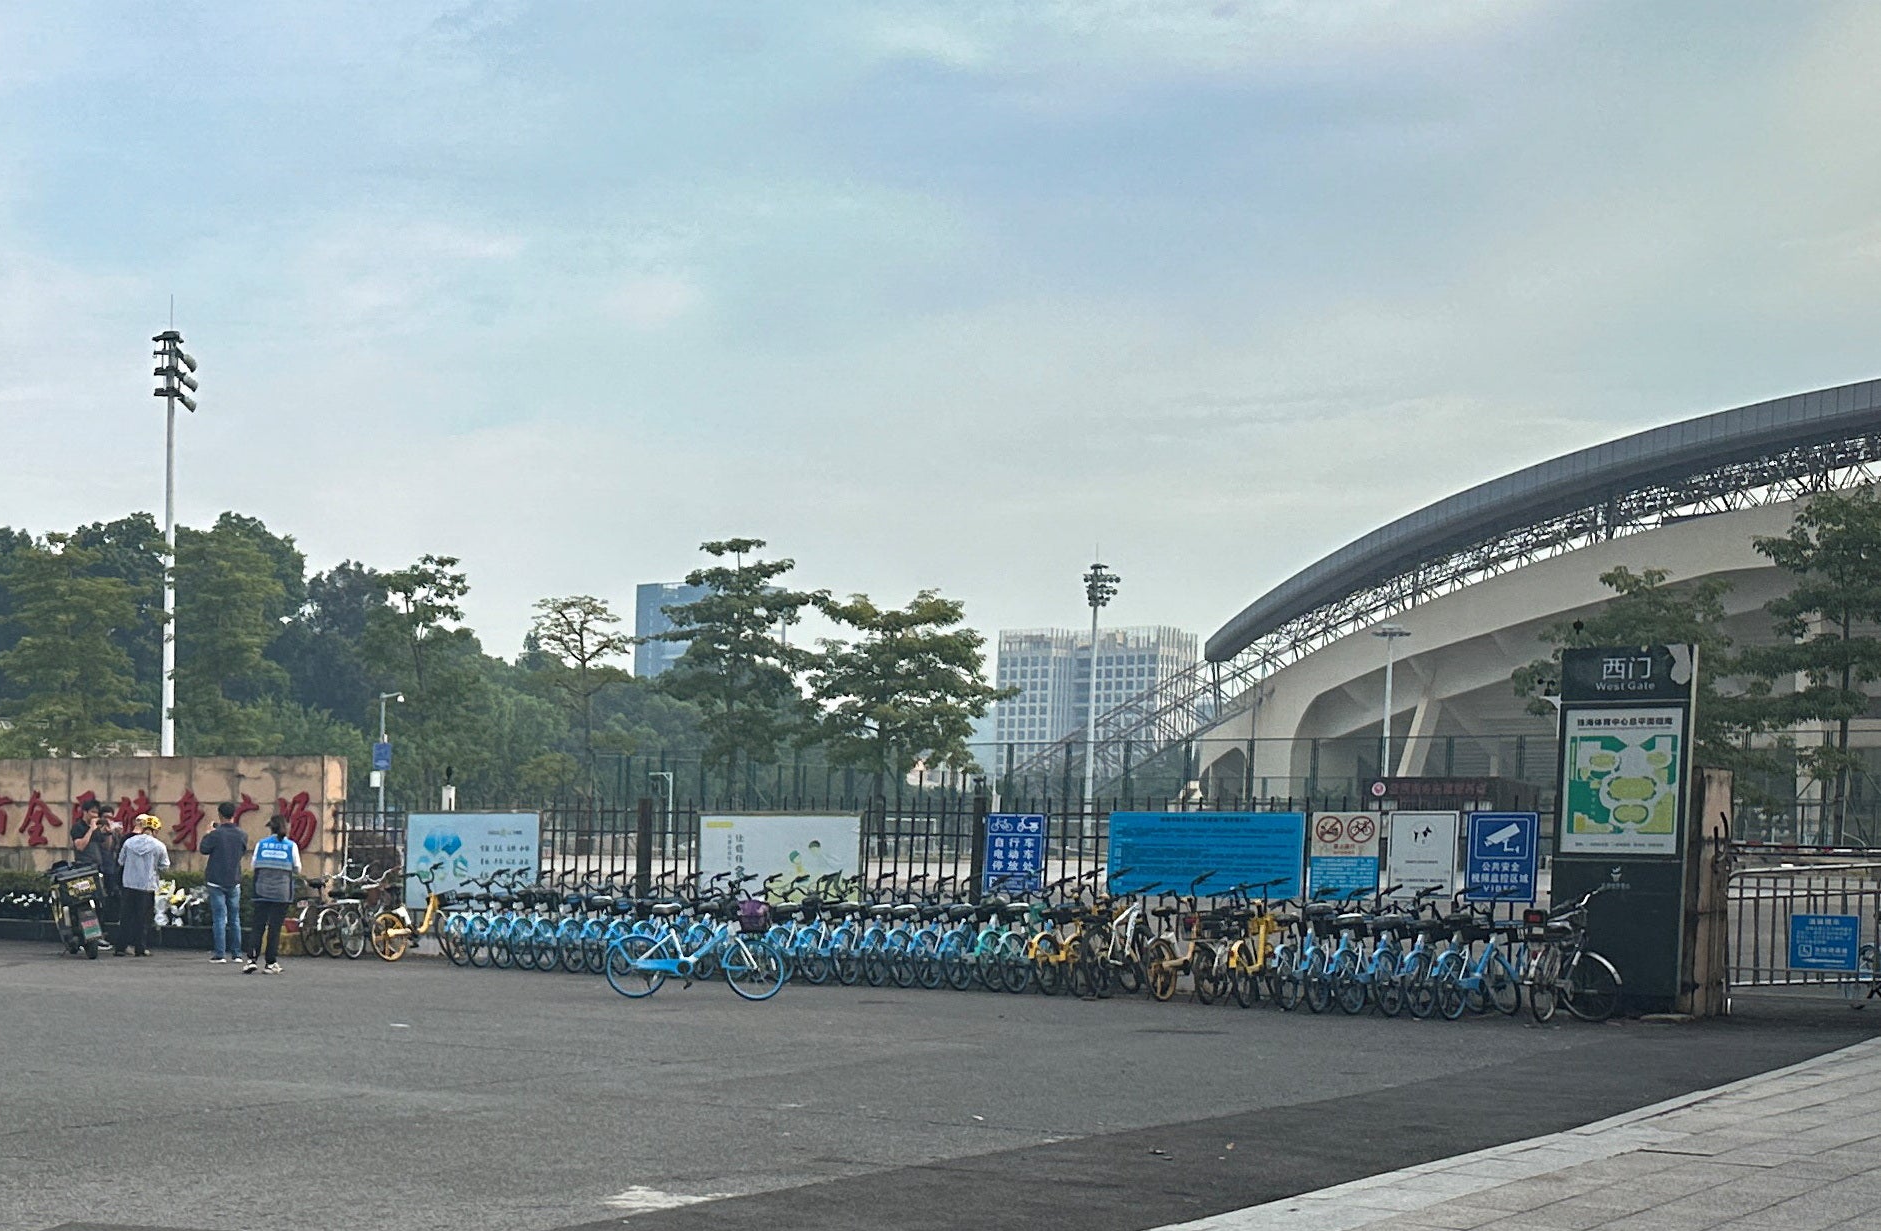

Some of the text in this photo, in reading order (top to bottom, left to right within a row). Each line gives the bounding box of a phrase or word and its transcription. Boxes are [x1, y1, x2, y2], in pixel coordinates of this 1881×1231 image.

[1602, 657, 1652, 680] 西门
[1595, 680, 1656, 692] West Gate
[995, 837, 1035, 848] 自行车
[993, 849, 1034, 860] 电动车
[992, 860, 1034, 872] 停放处
[1481, 861, 1520, 872] 公共安全
[1471, 873, 1529, 884] 视频监控区域
